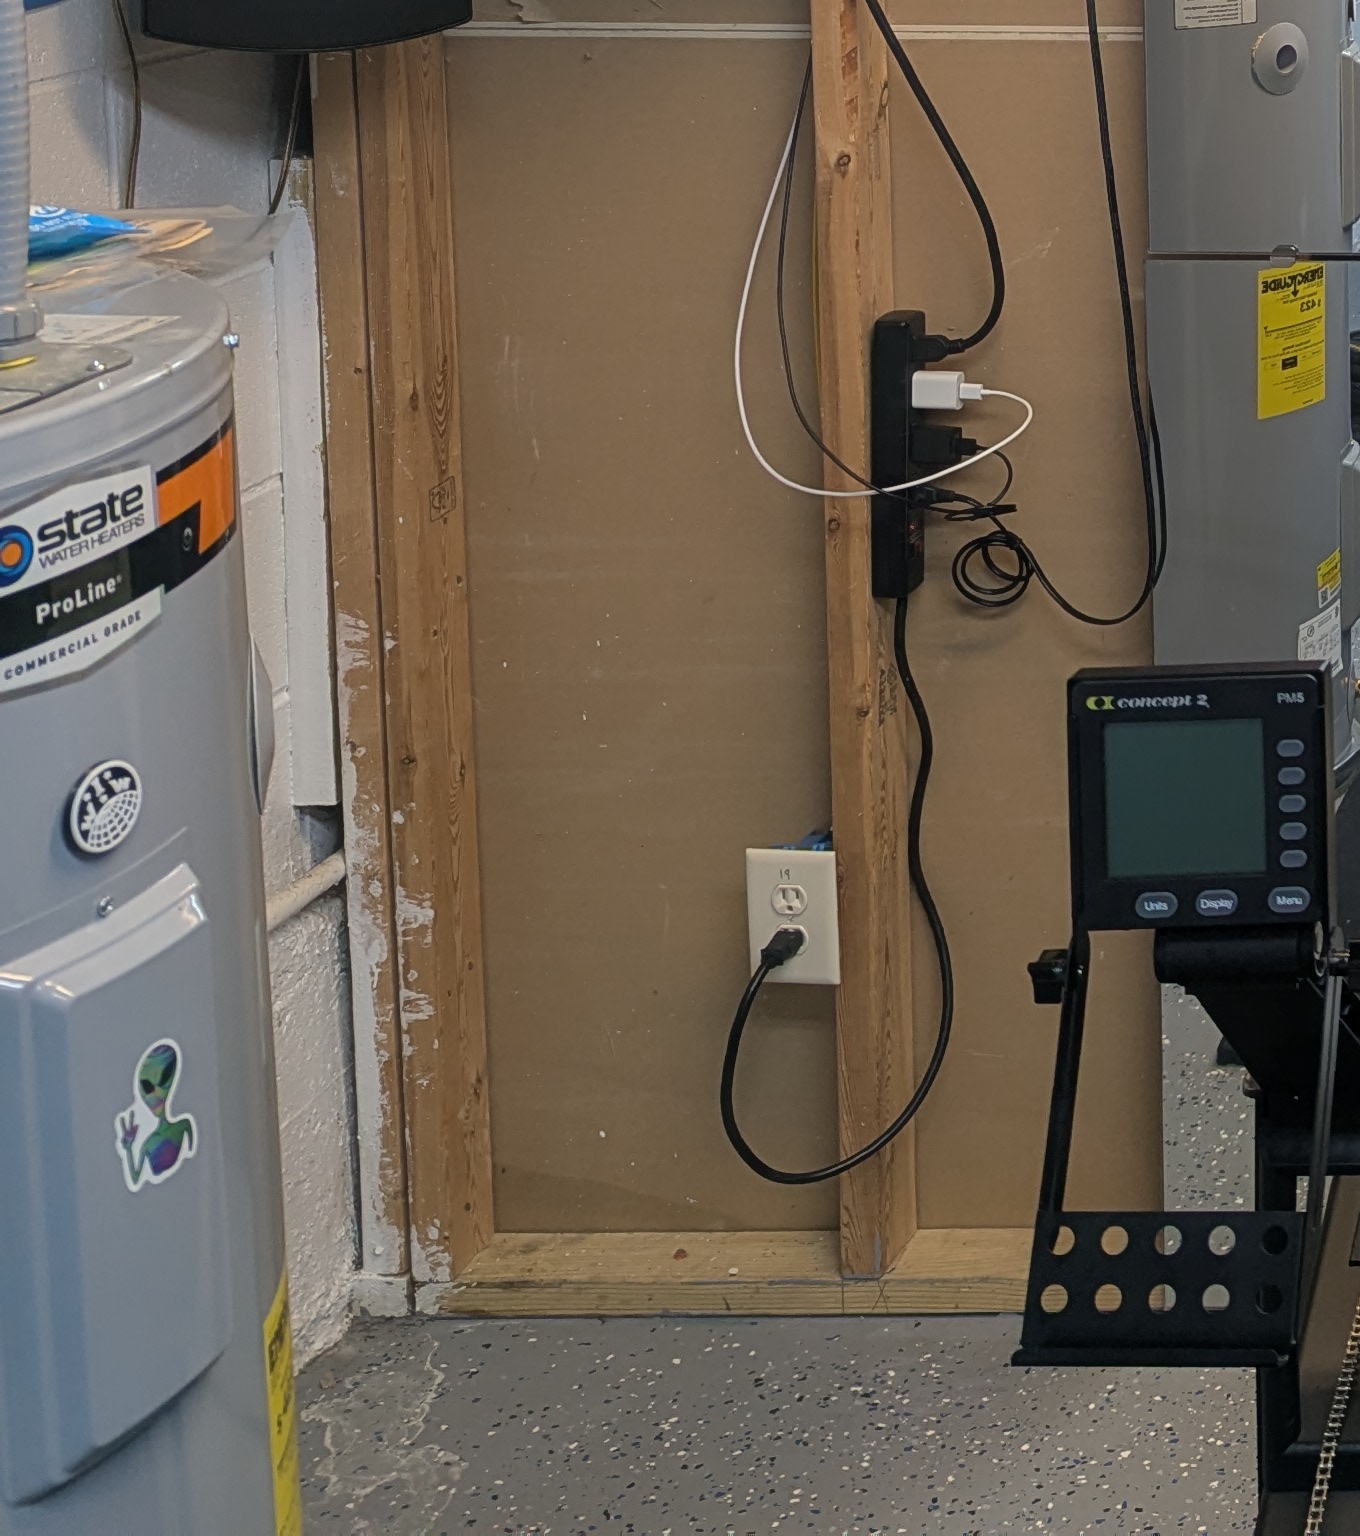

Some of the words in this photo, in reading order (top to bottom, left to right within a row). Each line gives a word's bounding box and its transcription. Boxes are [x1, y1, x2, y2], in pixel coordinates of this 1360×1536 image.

[37, 484, 144, 555] state
[39, 541, 90, 570] WATER
[90, 513, 145, 556] HEATERS
[3, 634, 99, 681] COMMERCIAL
[104, 610, 142, 638] GRADE
[1117, 694, 1192, 711] concept
[1277, 692, 1305, 704] PM5
[1144, 901, 1169, 911] Units
[1200, 898, 1234, 911] Display
[1276, 895, 1303, 906] Menu
